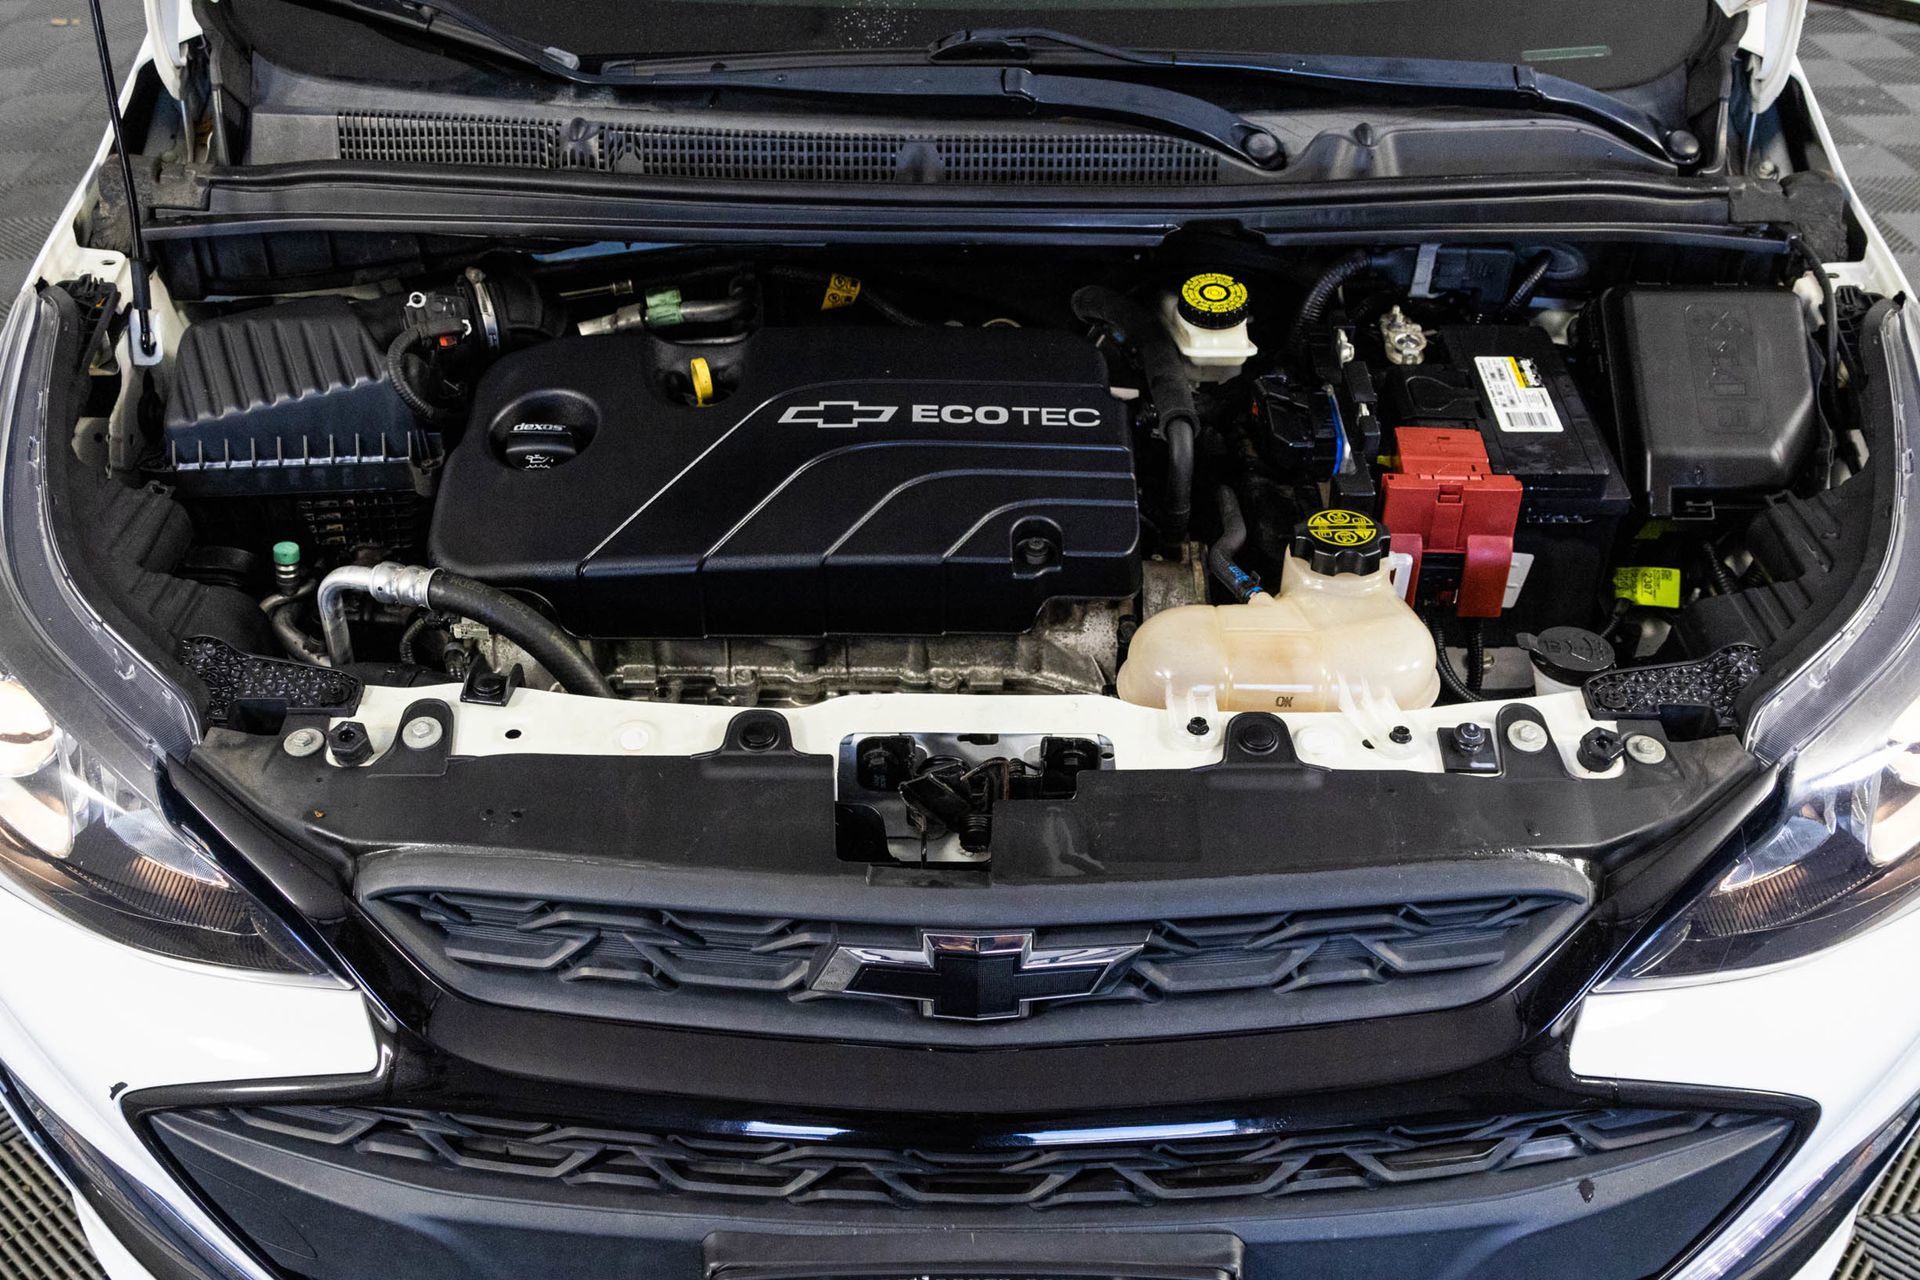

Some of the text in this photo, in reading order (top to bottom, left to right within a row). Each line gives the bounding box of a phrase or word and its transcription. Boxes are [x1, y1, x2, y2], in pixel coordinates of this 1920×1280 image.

[911, 404, 1101, 427] ECOTEC
[513, 422, 563, 431] dexos
[1275, 696, 1294, 708] OK
